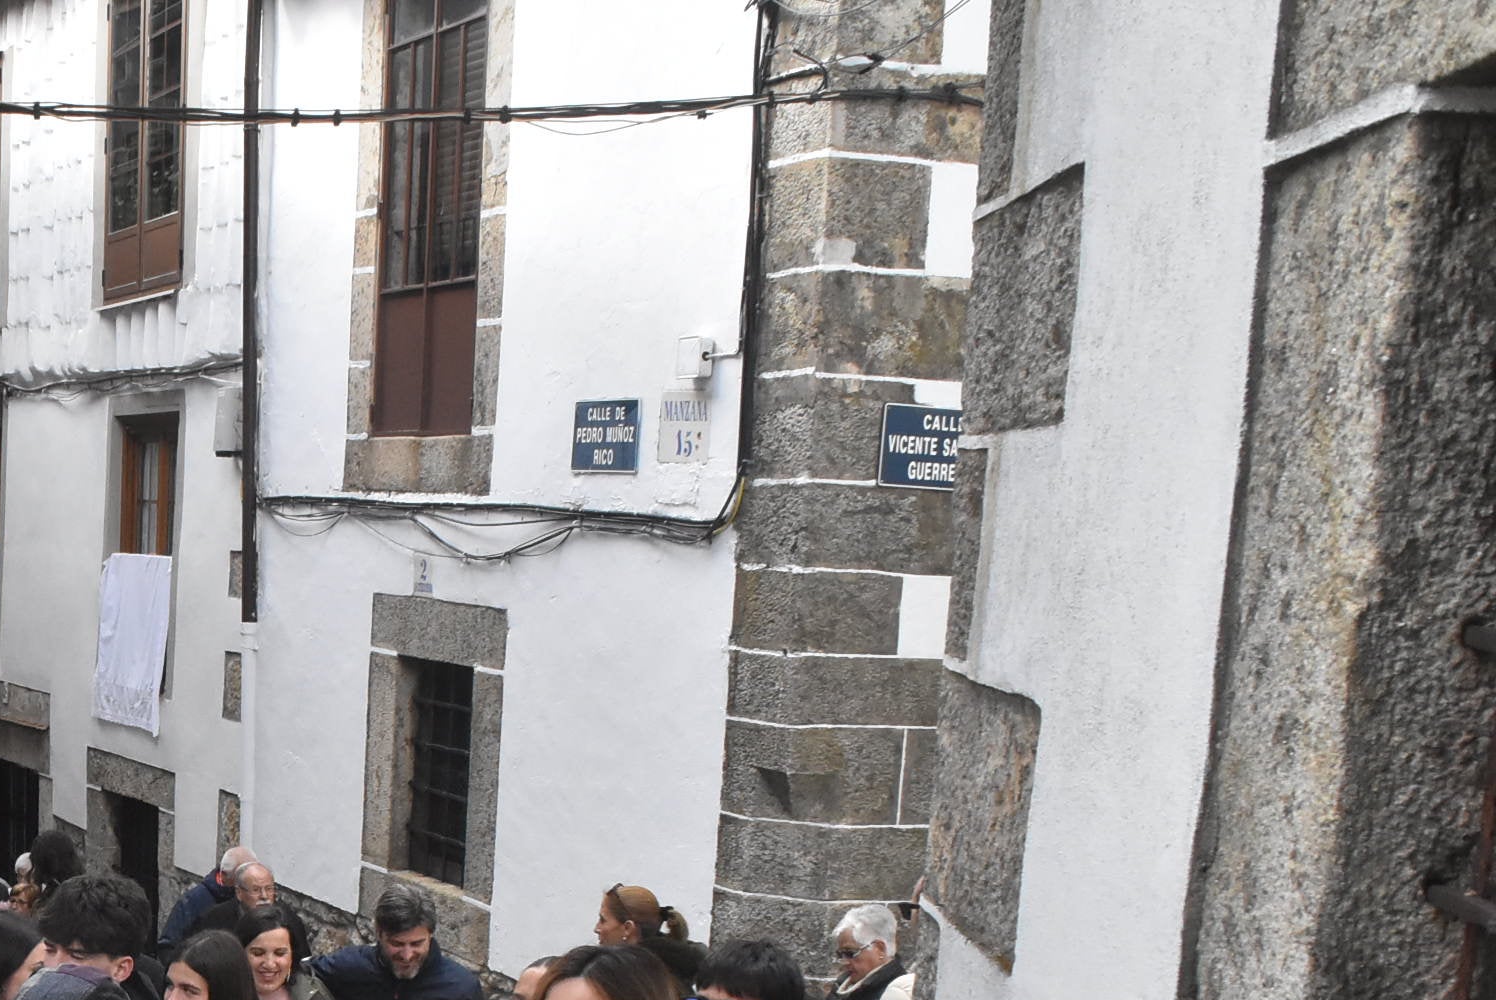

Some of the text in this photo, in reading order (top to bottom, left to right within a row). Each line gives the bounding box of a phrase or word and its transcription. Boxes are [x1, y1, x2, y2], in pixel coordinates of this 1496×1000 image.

[587, 406, 627, 421] CALLE DE
[664, 400, 708, 421] MANZANA
[576, 423, 635, 444] PEDRO MUÑOZ
[888, 434, 938, 456] VICENTE
[593, 448, 614, 466] RICO
[907, 461, 956, 482] GUERRE
